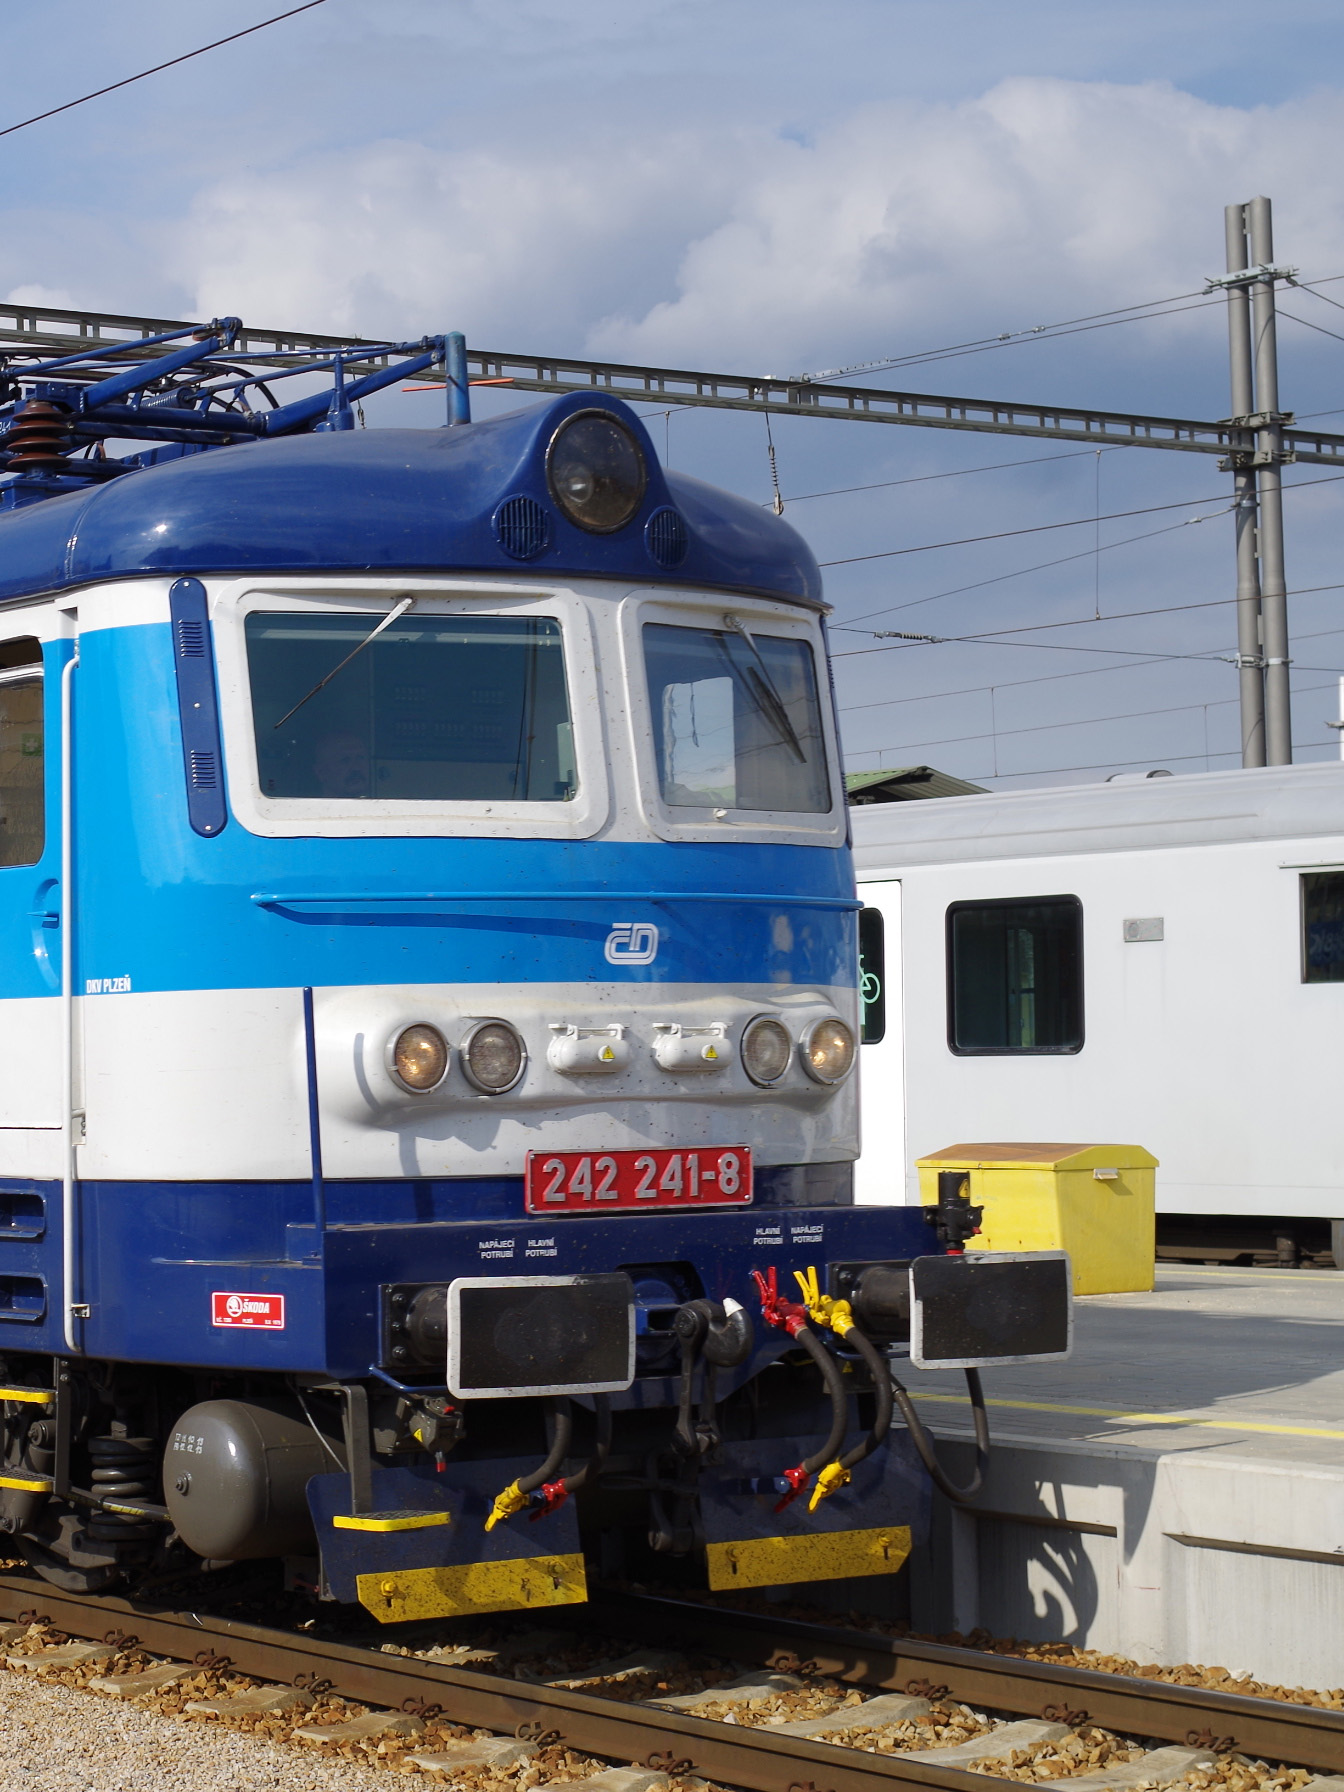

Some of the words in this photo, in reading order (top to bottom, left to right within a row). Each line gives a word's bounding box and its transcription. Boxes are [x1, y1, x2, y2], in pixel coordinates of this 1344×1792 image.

[86, 979, 102, 994] DKV
[103, 974, 131, 993] PLZEŇ
[542, 1156, 619, 1203] 242
[634, 1152, 741, 1199] 241-8
[756, 1225, 781, 1235] HLAVNÍ
[790, 1223, 824, 1235] NAPÁJECÍ
[479, 1237, 515, 1249] NAPÁJECÍ
[527, 1237, 555, 1247] HLAVNÍ
[753, 1235, 784, 1245] POTRUBÍ
[792, 1233, 823, 1244] POTRUBÍ
[481, 1247, 514, 1259] POTRUBÍ
[525, 1246, 558, 1257] POTRUBÍ
[242, 1298, 270, 1314] ŠKODA
